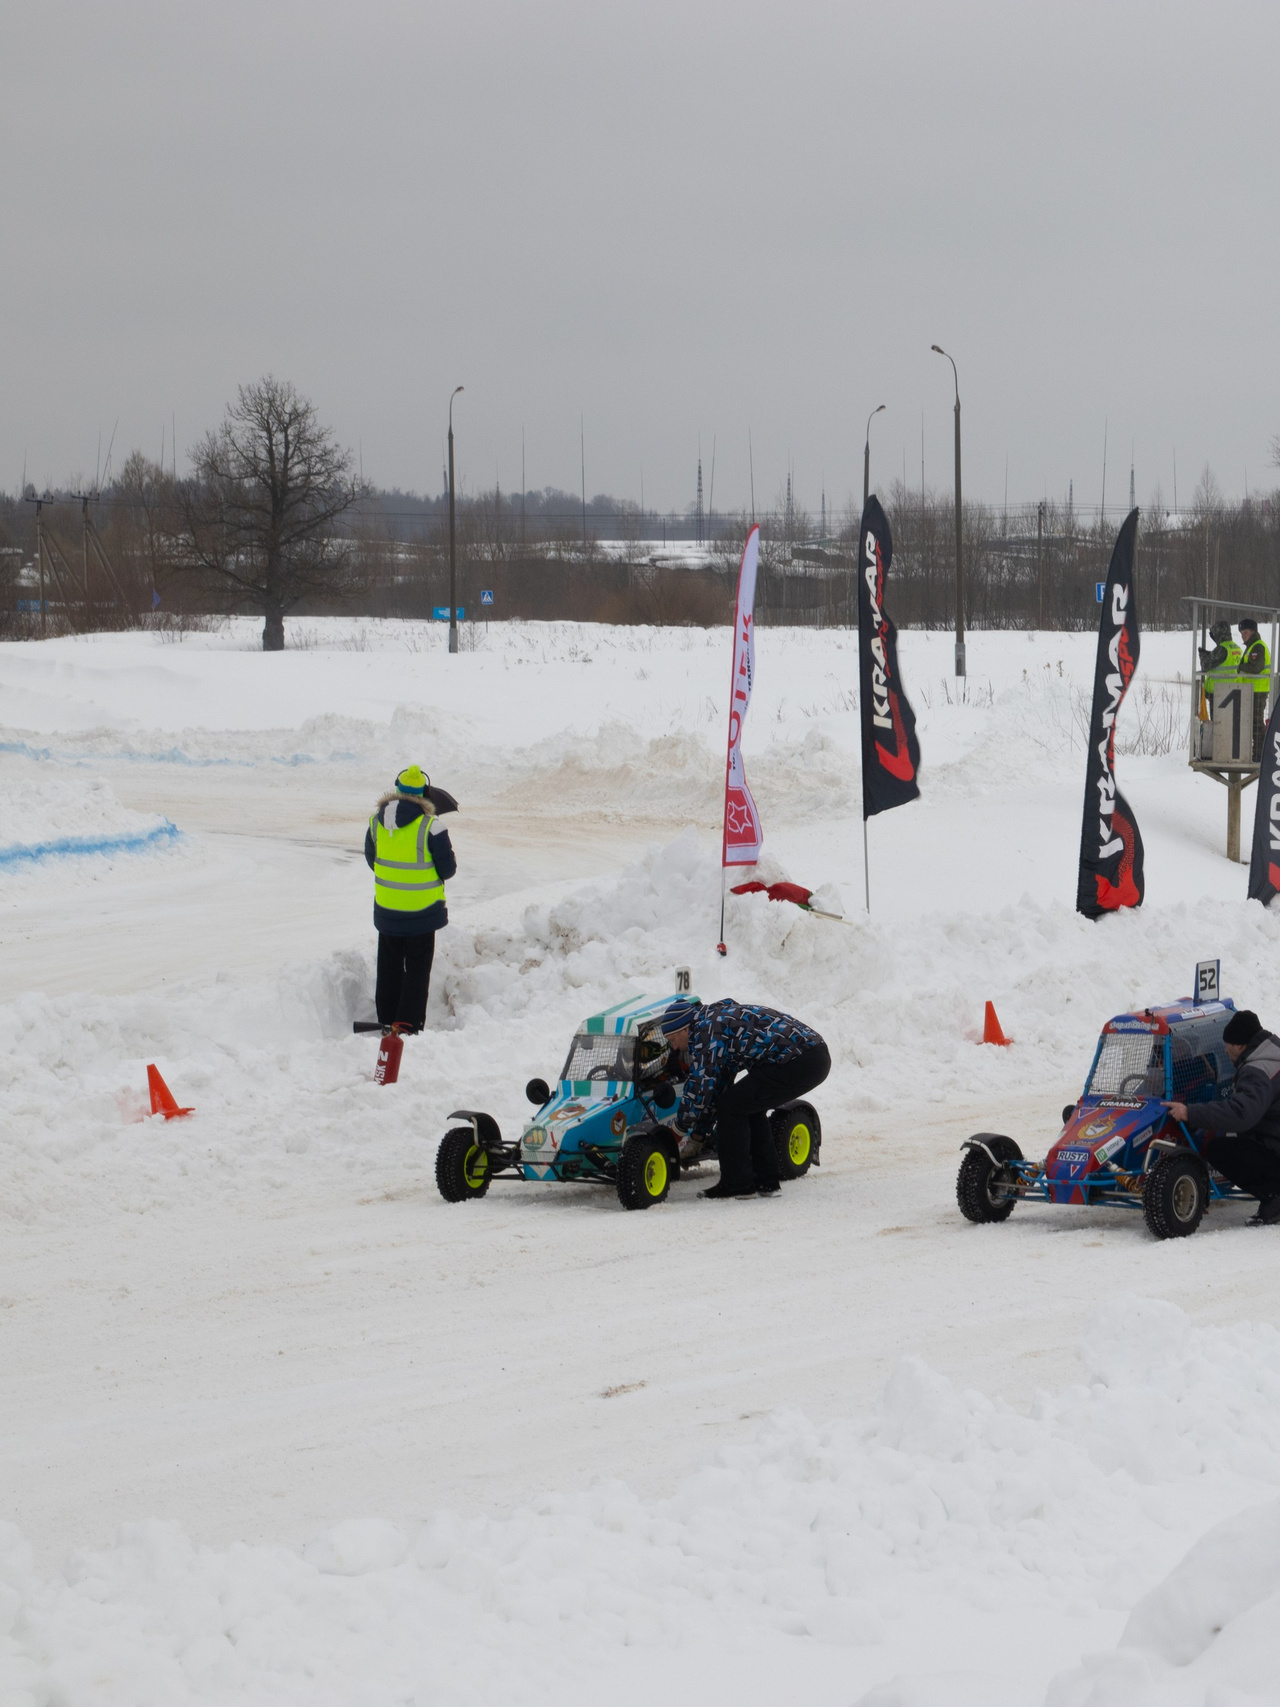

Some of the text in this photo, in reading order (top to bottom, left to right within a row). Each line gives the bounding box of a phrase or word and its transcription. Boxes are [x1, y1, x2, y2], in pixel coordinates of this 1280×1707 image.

[1218, 689, 1242, 760] 1
[677, 971, 690, 992] 78
[1200, 968, 1216, 992] 52
[1100, 1101, 1142, 1109] KRAMAR
[1058, 1151, 1089, 1162] RUSTA
